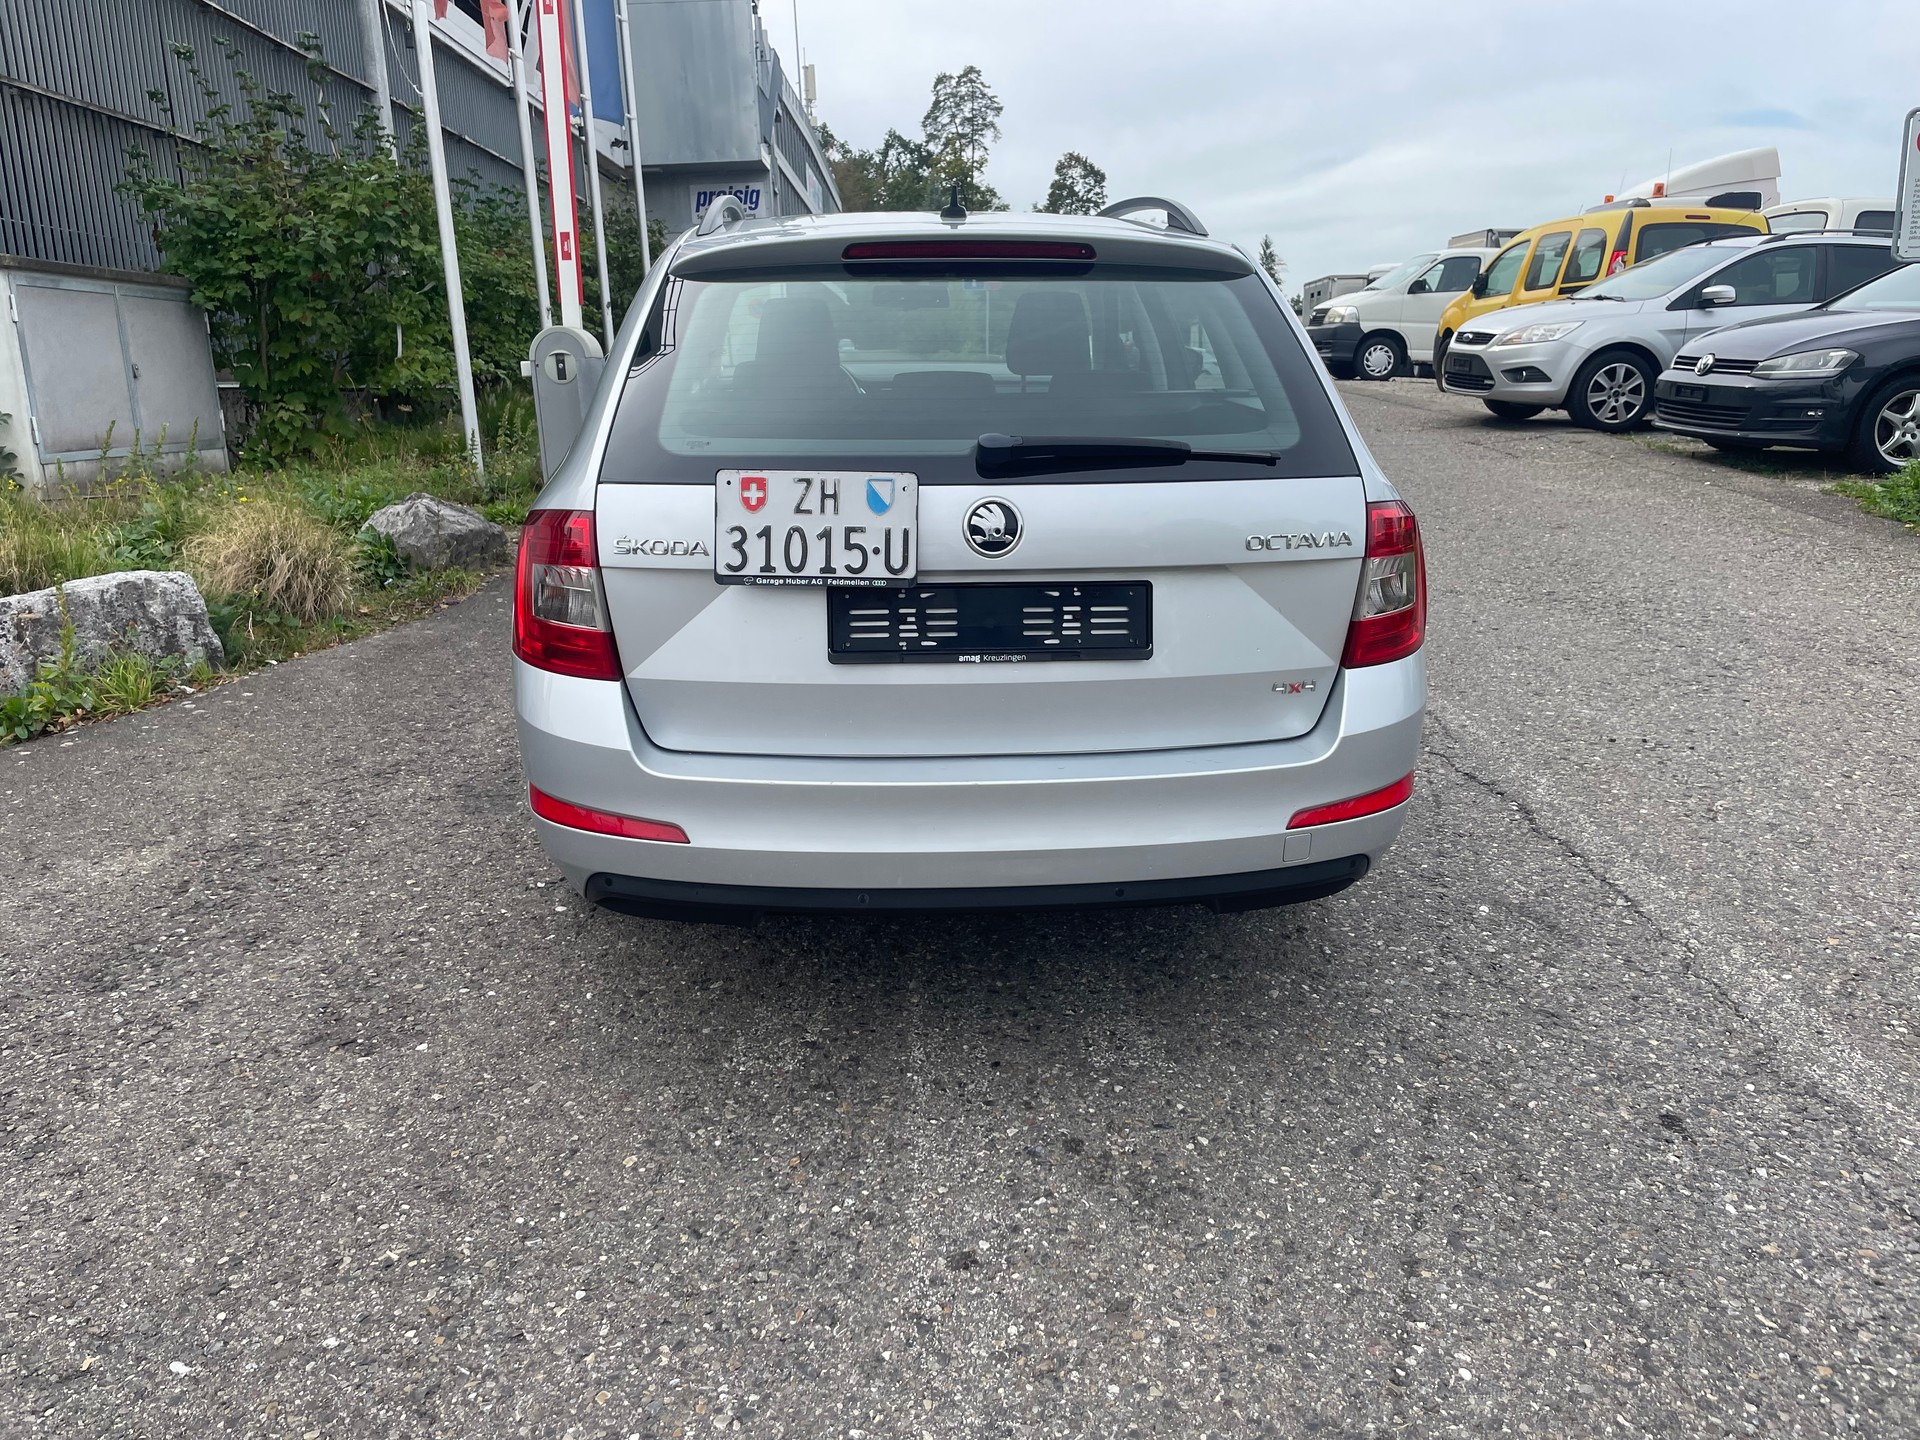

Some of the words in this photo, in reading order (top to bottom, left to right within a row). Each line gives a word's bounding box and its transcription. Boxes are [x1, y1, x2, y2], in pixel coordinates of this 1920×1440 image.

[793, 477, 841, 515] ZH
[1245, 531, 1353, 551] OCTAVIA
[756, 577, 784, 586] Garage
[785, 577, 809, 585] Huber
[810, 578, 823, 586] AG
[958, 654, 981, 663] amag
[983, 654, 1027, 663] Kreuzlingen
